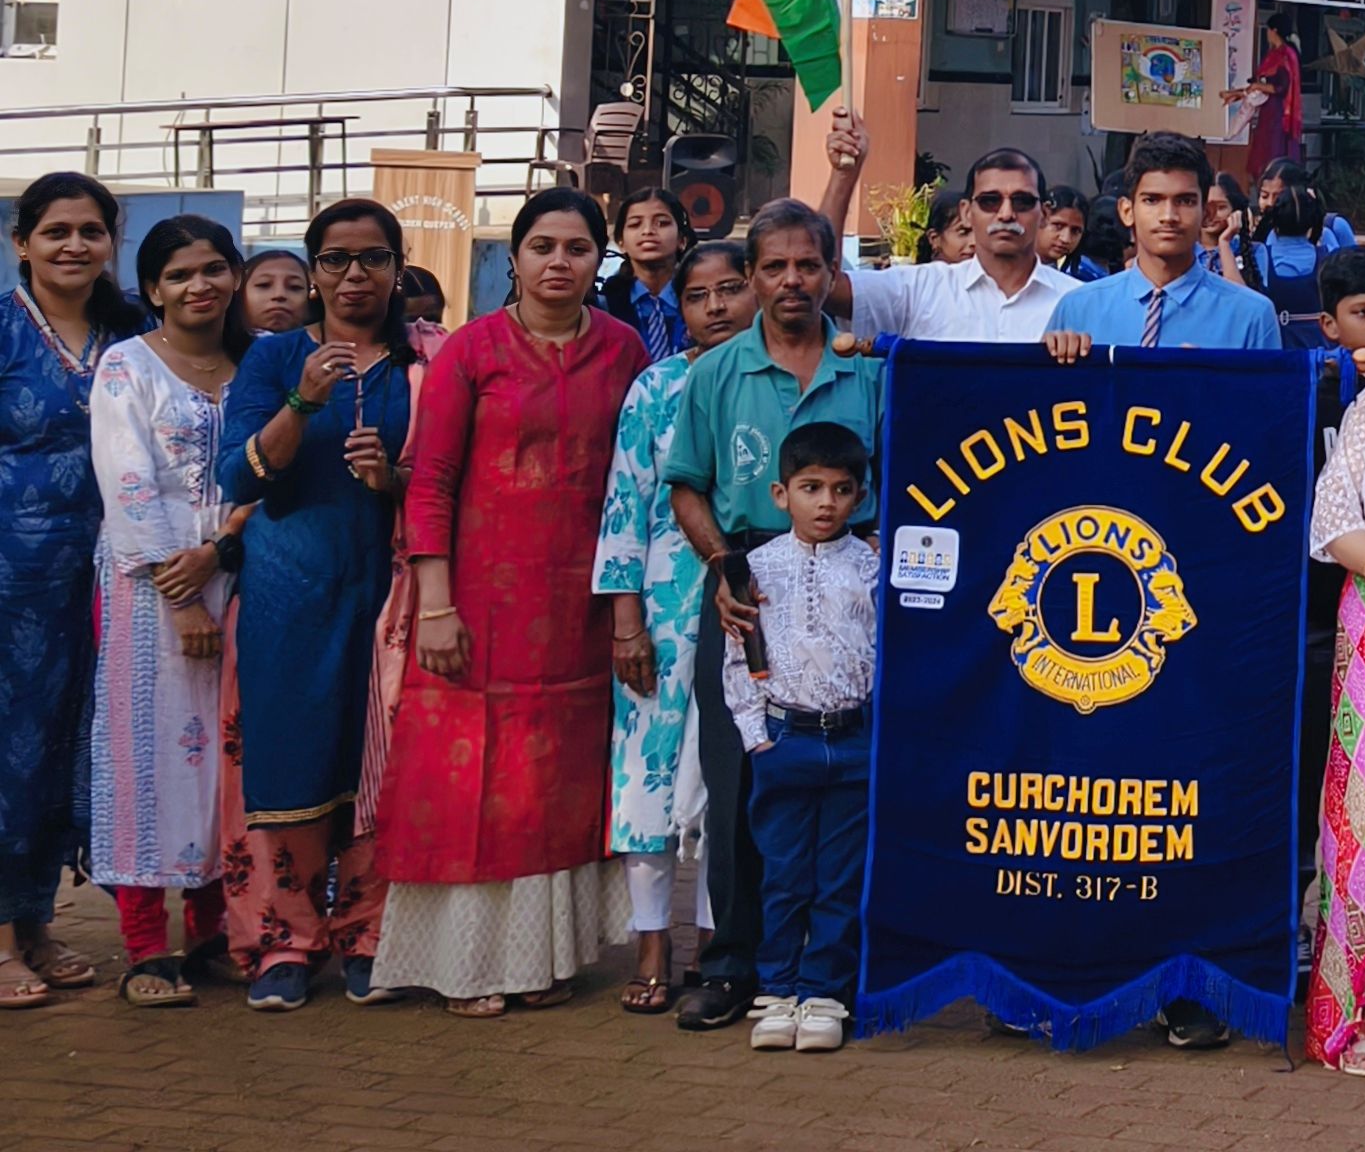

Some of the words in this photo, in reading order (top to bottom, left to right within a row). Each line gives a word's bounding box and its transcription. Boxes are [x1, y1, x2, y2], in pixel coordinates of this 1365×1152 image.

[906, 401, 1090, 520] LIONS
[1122, 406, 1286, 532] CLUB
[1038, 516, 1153, 560] LIONS
[1071, 573, 1121, 642] L
[1031, 654, 1141, 691] INTERNATIONAL
[967, 771, 1198, 816] CURCHOREM
[966, 818, 1194, 862] SANVORDEM
[996, 869, 1062, 898] DIST.
[1076, 875, 1158, 901] 317-B
